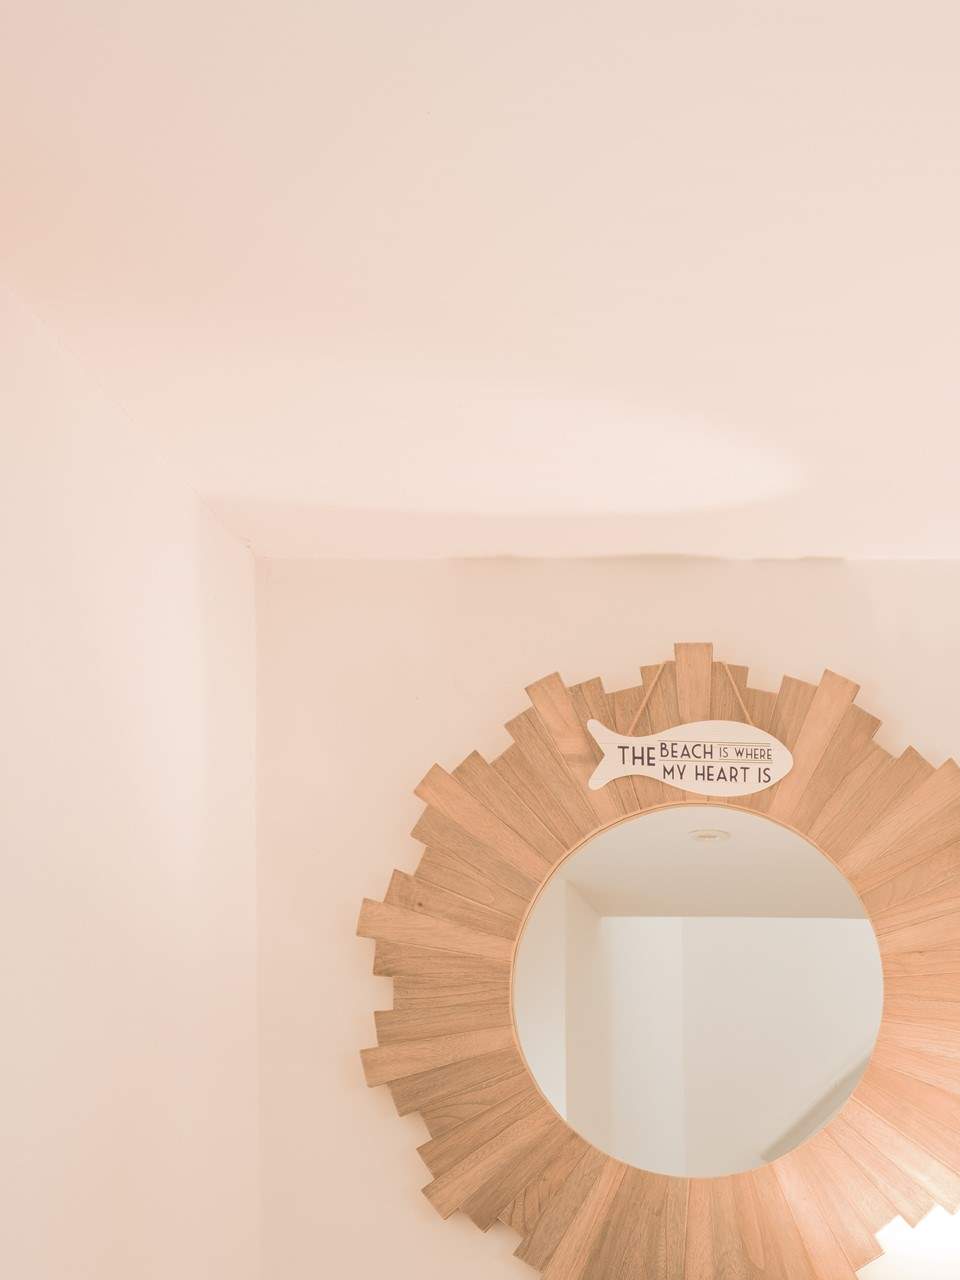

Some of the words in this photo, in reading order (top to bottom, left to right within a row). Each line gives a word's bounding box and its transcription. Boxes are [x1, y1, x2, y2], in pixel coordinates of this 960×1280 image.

[617, 745, 656, 767] THE
[660, 742, 713, 760] BEACH
[719, 747, 729, 759] IS
[734, 747, 772, 760] WHERE
[663, 764, 686, 780] MY
[695, 765, 750, 783] HEART
[758, 767, 772, 783] IS
